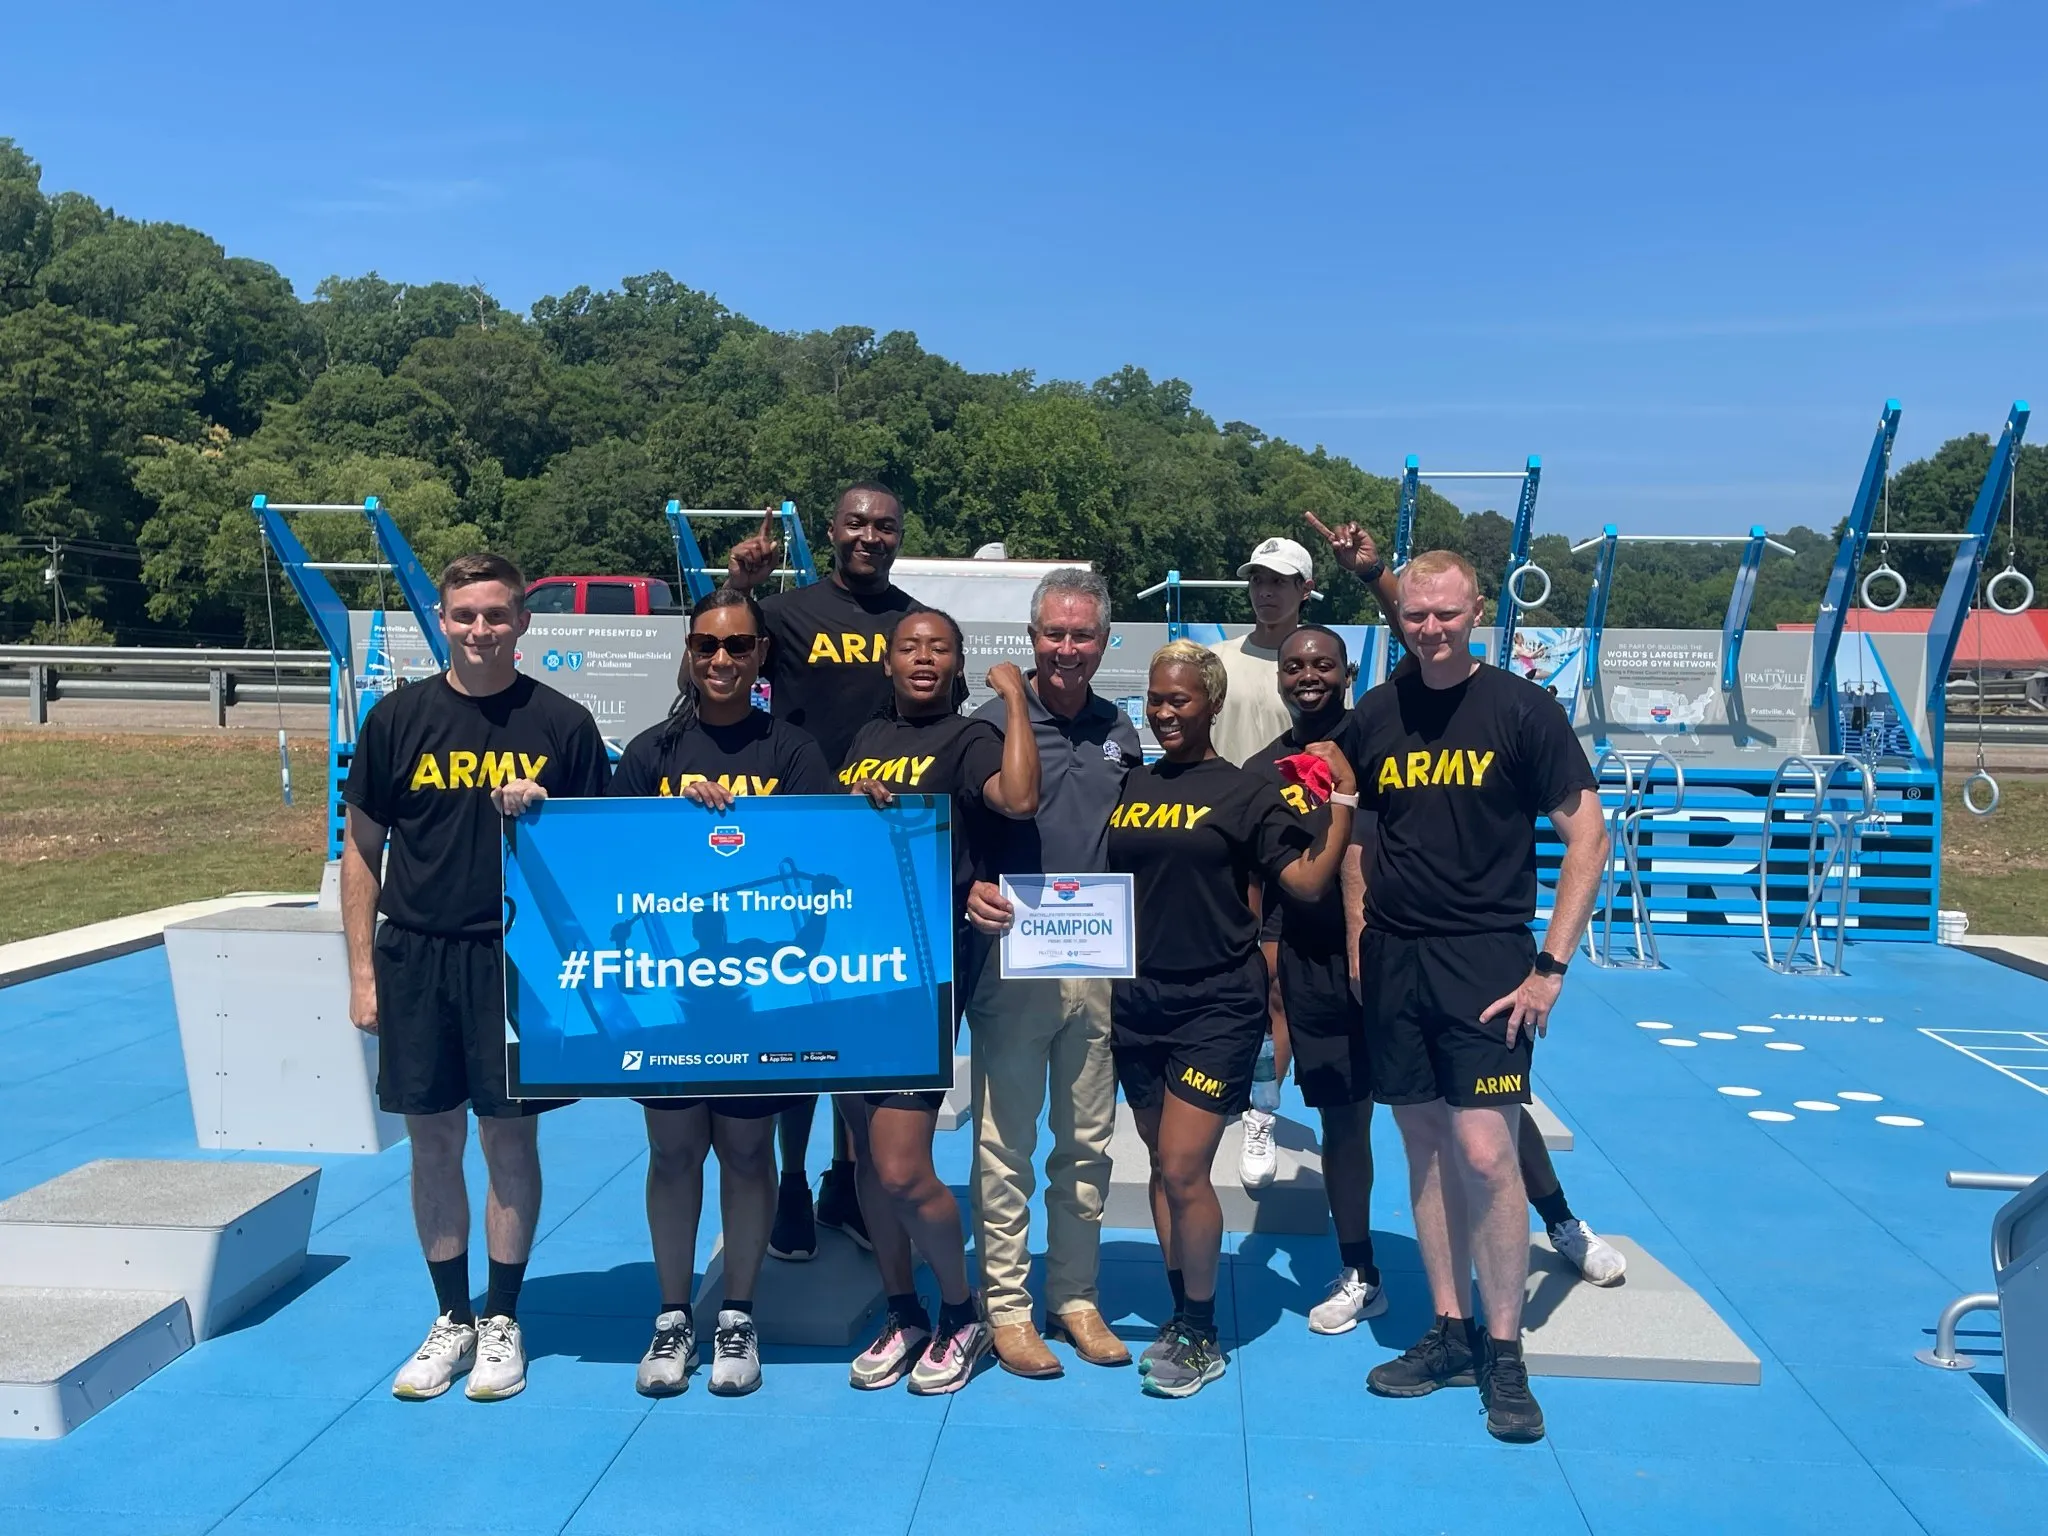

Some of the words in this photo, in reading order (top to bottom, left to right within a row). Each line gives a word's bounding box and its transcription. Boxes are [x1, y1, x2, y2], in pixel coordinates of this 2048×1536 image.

[588, 628, 643, 637] PRESENTED
[645, 629, 658, 637] BY
[968, 634, 991, 645] THE
[995, 635, 1032, 646] FITNE
[587, 650, 627, 659] BlueCross
[628, 651, 672, 660] BlueShield
[980, 647, 1003, 655] BEST
[1007, 648, 1034, 656] OUTD
[1607, 650, 1648, 659] WORLD'S
[1650, 651, 1689, 660] LARGEST
[1692, 652, 1714, 660] FREE
[587, 659, 595, 668] of
[597, 660, 632, 669] Alabama
[1603, 659, 1648, 668] OUTDOOR
[1651, 660, 1671, 668] GYM
[1673, 660, 1717, 668] NETWORK
[1744, 672, 1806, 684] PRATTVILLE
[1751, 707, 1785, 716] Prattville,
[1786, 708, 1796, 716] AL
[410, 750, 548, 792] ARMY
[838, 755, 936, 786] ARMY
[1378, 749, 1495, 794] ARMY
[1109, 802, 1212, 830] ARMY
[616, 893, 623, 914] I
[632, 892, 705, 914] Made
[712, 891, 730, 913] It
[736, 888, 853, 916] Through!
[1020, 918, 1113, 936] CHAMPION
[557, 944, 908, 990] #FitnessCourt
[650, 1054, 701, 1066] FITNESS
[704, 1053, 749, 1065] COURT
[1181, 1067, 1227, 1098] ARMY
[1474, 1074, 1522, 1095] ARMY
